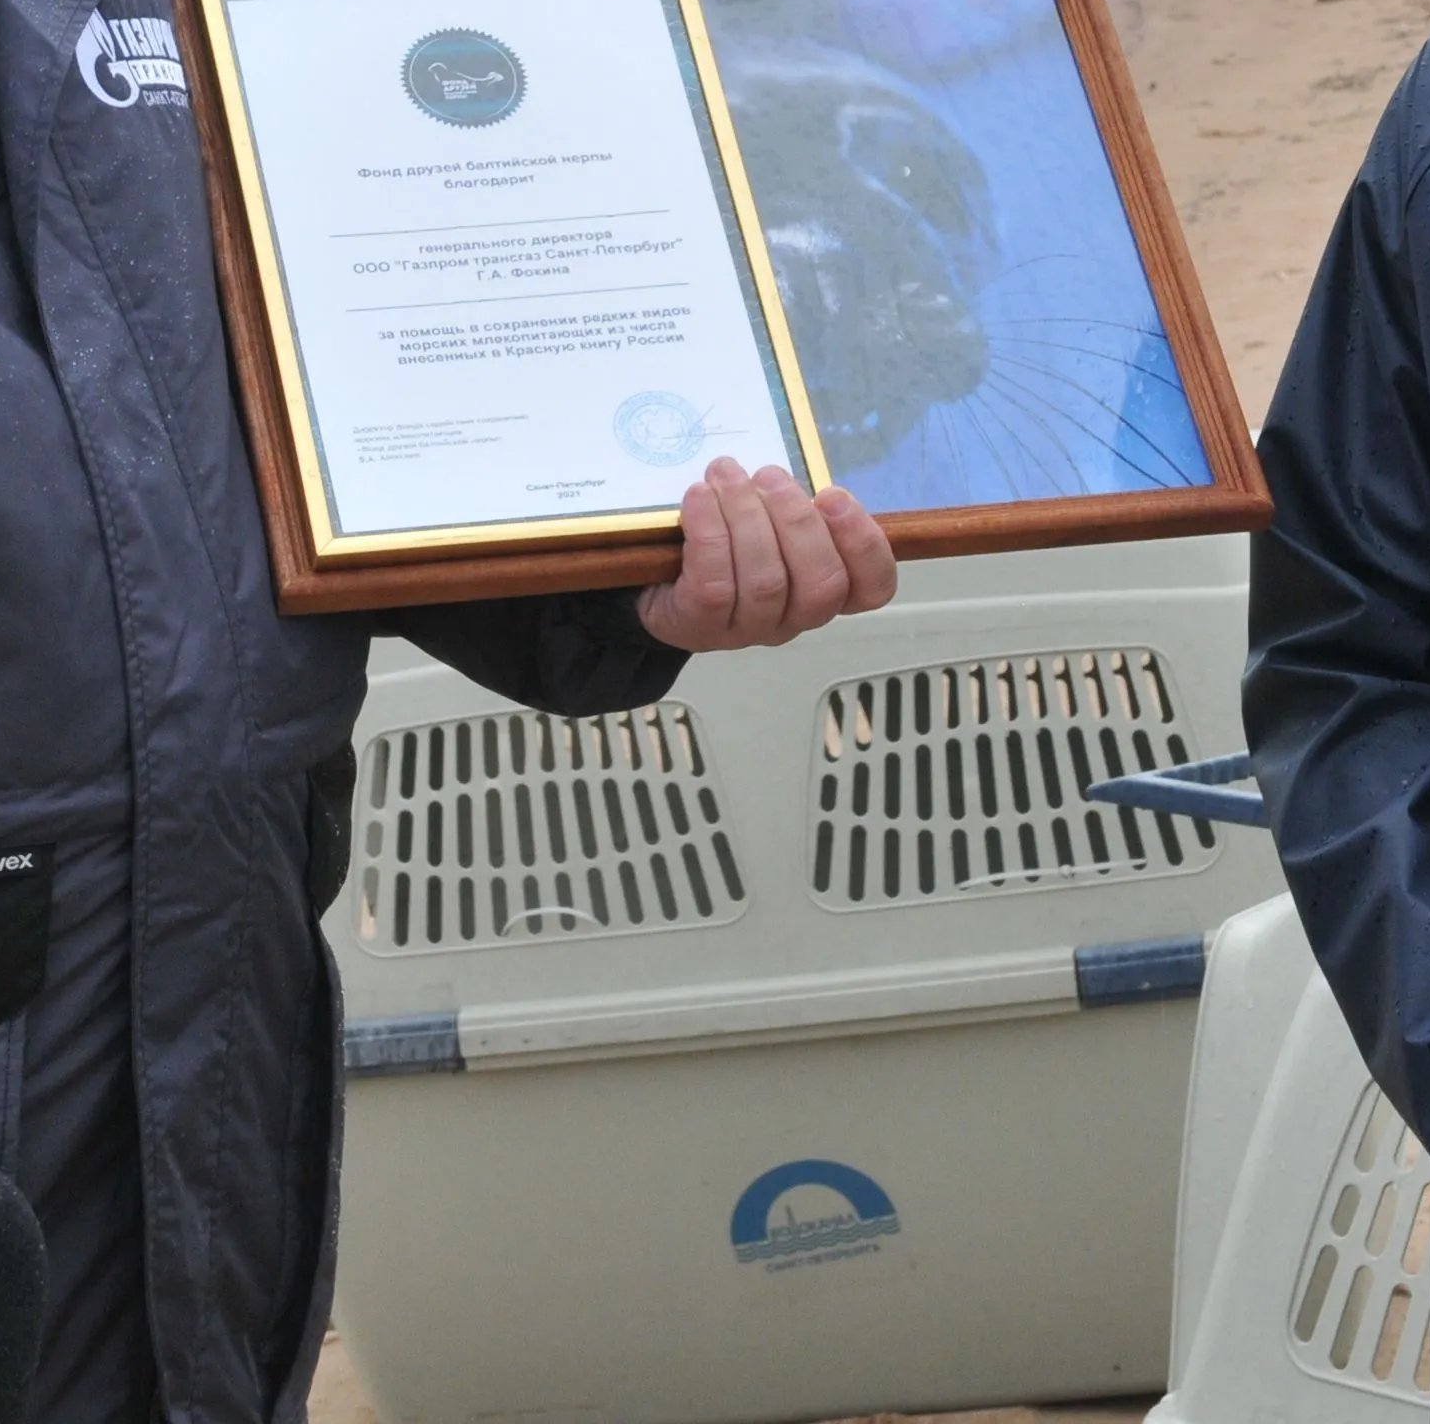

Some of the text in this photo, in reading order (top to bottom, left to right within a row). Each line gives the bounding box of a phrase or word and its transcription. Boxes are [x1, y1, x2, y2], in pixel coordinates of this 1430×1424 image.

[357, 152, 613, 179] Фонд друзей балтийской нерпы
[443, 174, 536, 190] благодарит
[352, 237, 684, 274] ООО "Газпром трансгаз Санкт-Петербург"
[418, 229, 613, 255] генерального директора
[476, 264, 571, 281] Г.А. Фокина
[377, 306, 691, 341] за помощь в сохранении редких видов
[399, 320, 677, 354] морских млекопитающих из числа
[397, 332, 686, 366] внесенных в Красную книгу России
